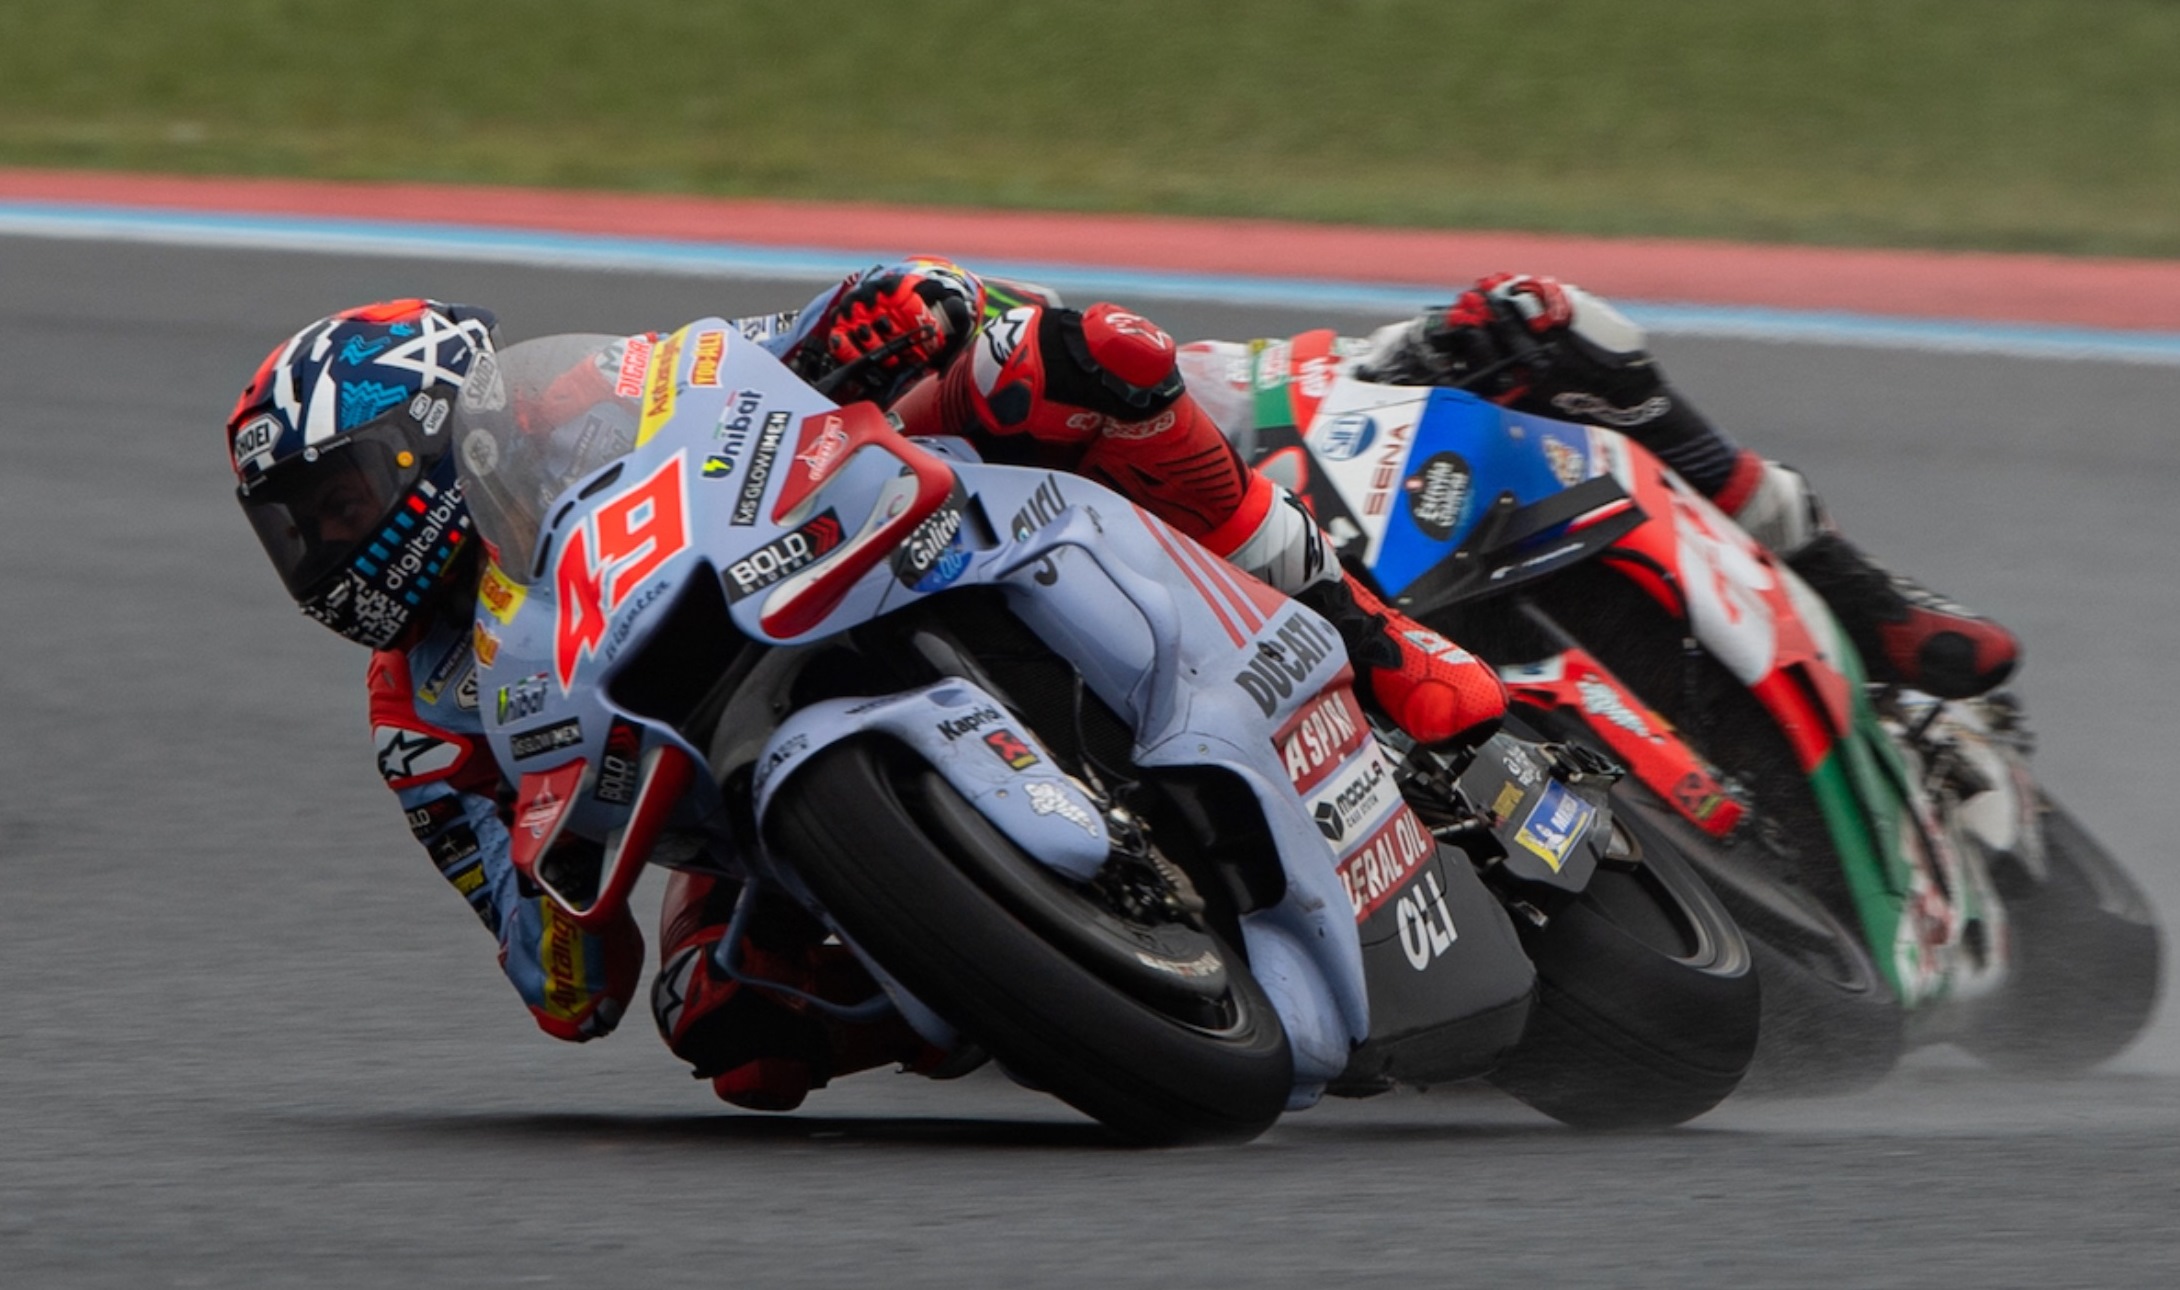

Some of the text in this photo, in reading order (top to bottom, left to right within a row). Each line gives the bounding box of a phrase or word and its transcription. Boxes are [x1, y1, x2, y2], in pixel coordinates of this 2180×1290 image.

[736, 500, 757, 524] MS
[745, 454, 773, 500] GLOW
[557, 450, 691, 694] 49
[729, 532, 808, 586] BOLD
[1234, 612, 1333, 719] DUCATI
[1396, 870, 1458, 971] OLI
